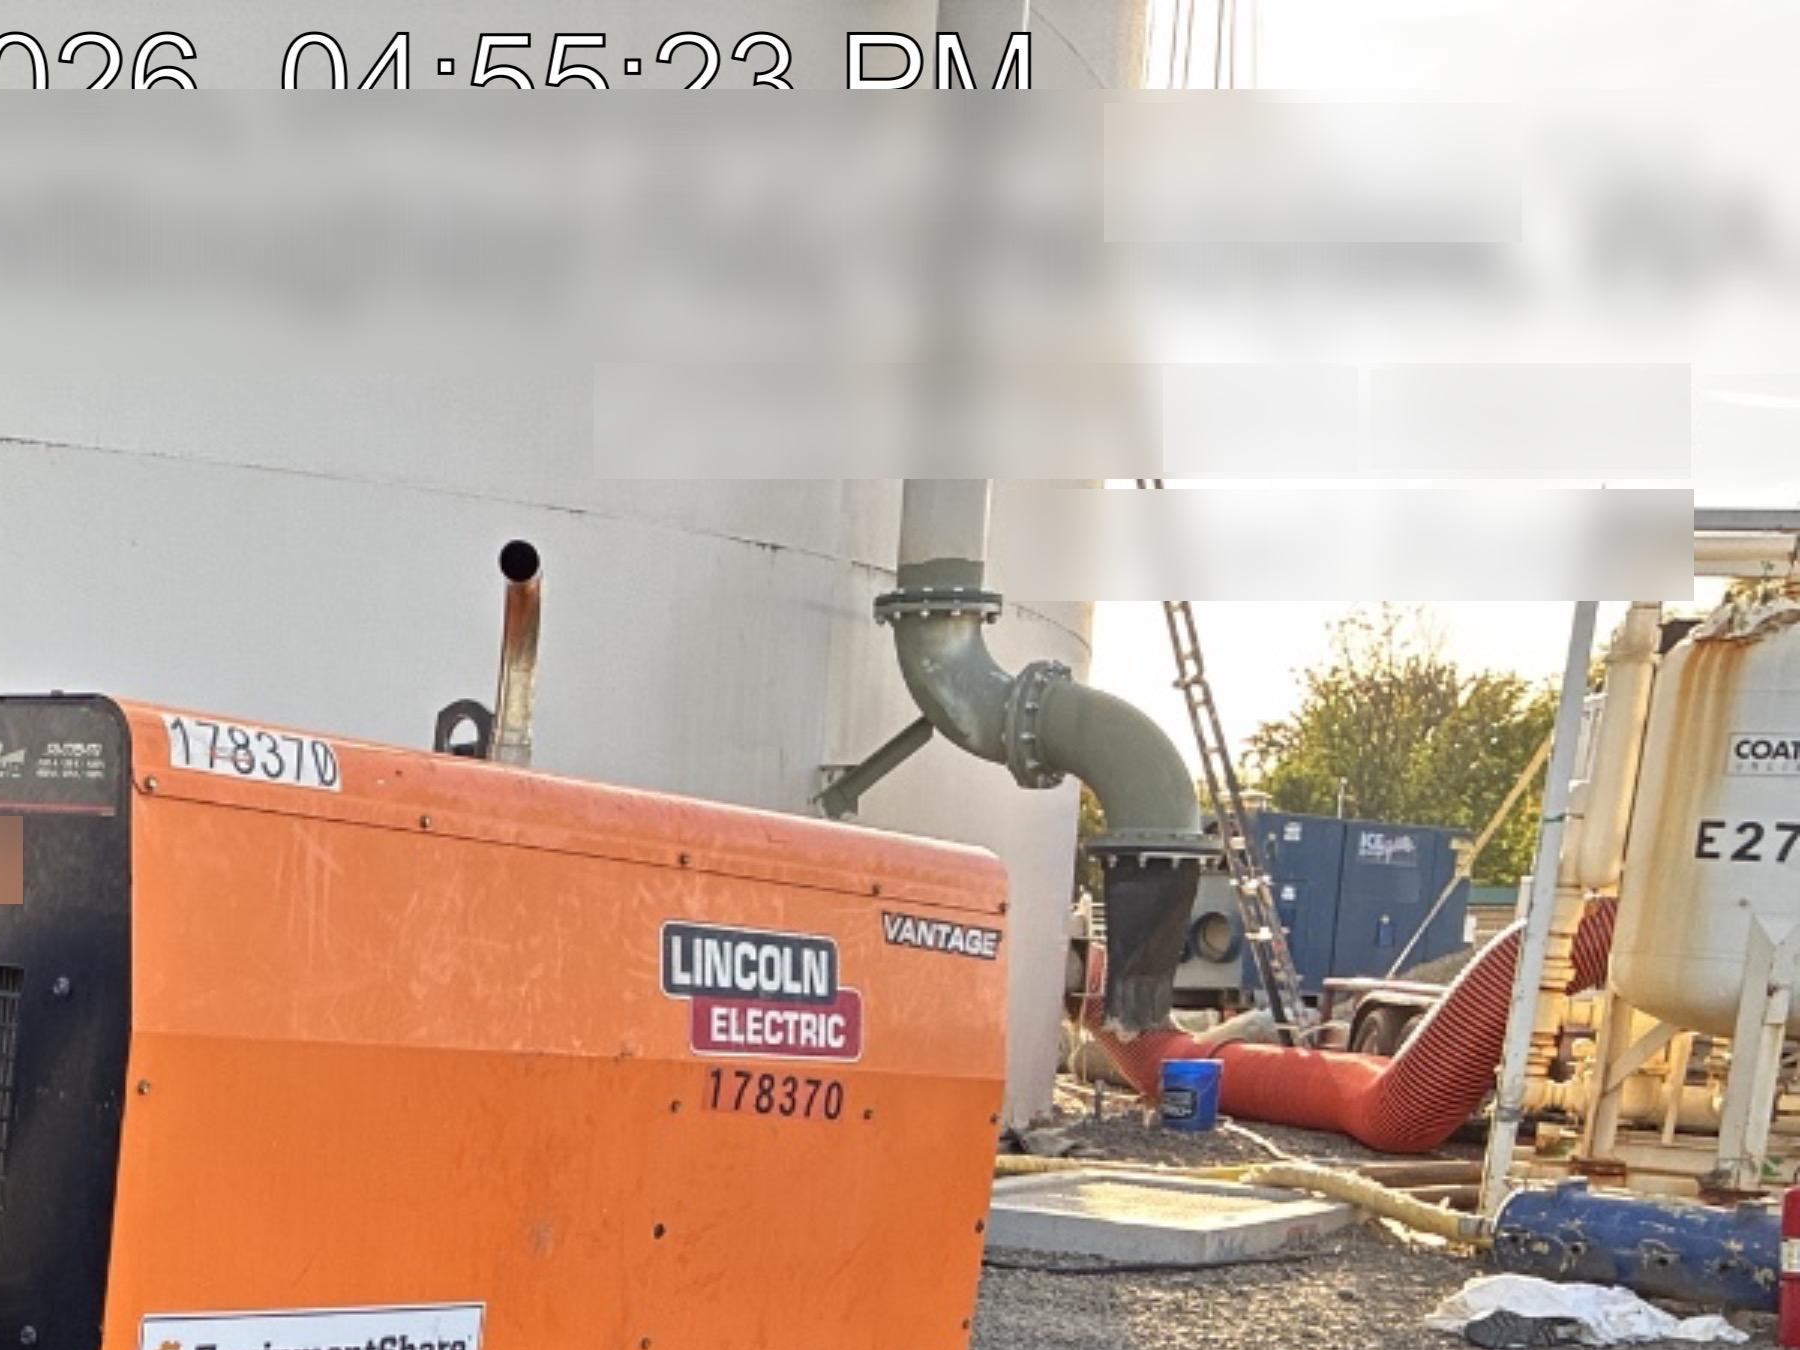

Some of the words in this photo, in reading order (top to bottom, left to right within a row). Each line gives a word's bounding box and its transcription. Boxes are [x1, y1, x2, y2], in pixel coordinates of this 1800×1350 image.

[170, 716, 338, 787] 178370
[1695, 820, 1800, 862] E27
[883, 914, 1000, 957] VANTAGE
[669, 934, 829, 997] LINCOLN
[710, 1006, 846, 1048] ELECTRIC
[709, 1067, 844, 1121] 178370
